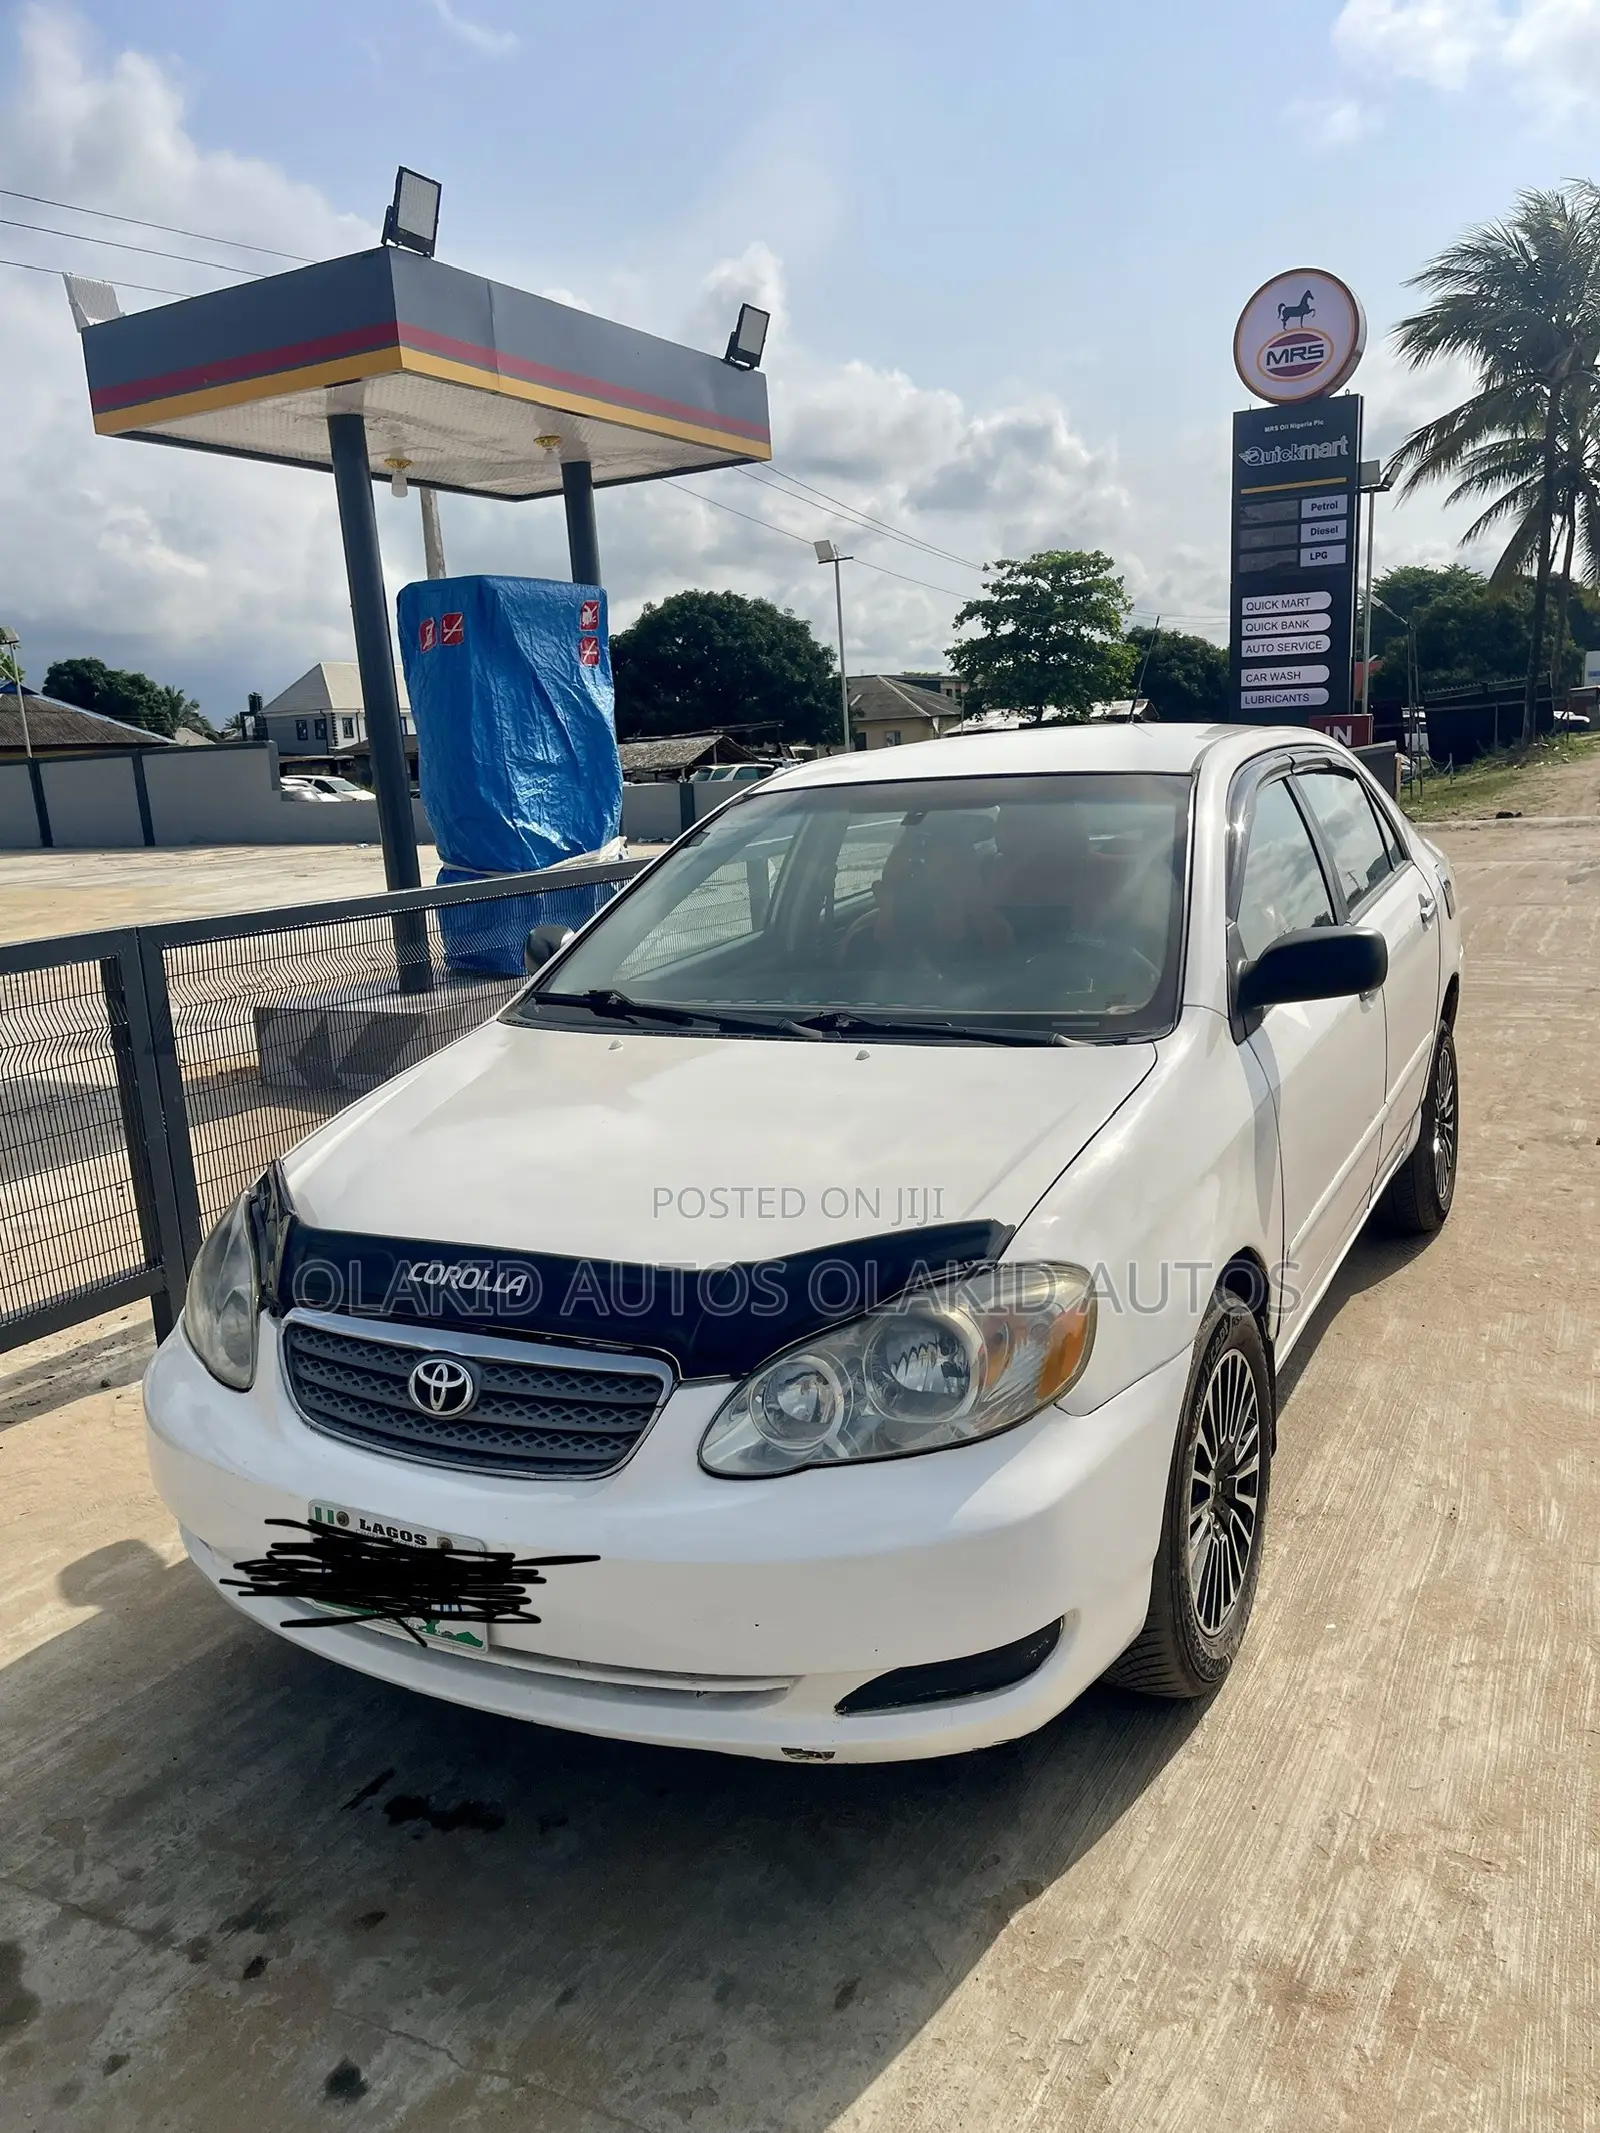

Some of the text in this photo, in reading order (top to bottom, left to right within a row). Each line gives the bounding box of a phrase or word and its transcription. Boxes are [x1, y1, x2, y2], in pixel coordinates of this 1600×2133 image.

[1266, 343, 1325, 366] MRS
[1290, 421, 1312, 429] Nigeria
[1240, 435, 1348, 466] Quickmart
[1311, 501, 1338, 512] Petrol
[1310, 525, 1339, 536] Diesel
[1310, 551, 1328, 561] LPG
[1246, 597, 1310, 611] QUICK MART
[1246, 620, 1309, 632] QUICK BANK
[1246, 640, 1322, 654] AUTO SERVICE
[1246, 671, 1301, 683] CAR WASH
[1245, 693, 1310, 705] LUBRICANTS
[406, 1262, 528, 1297] COROLLA
[359, 1518, 428, 1546] LAGOS
